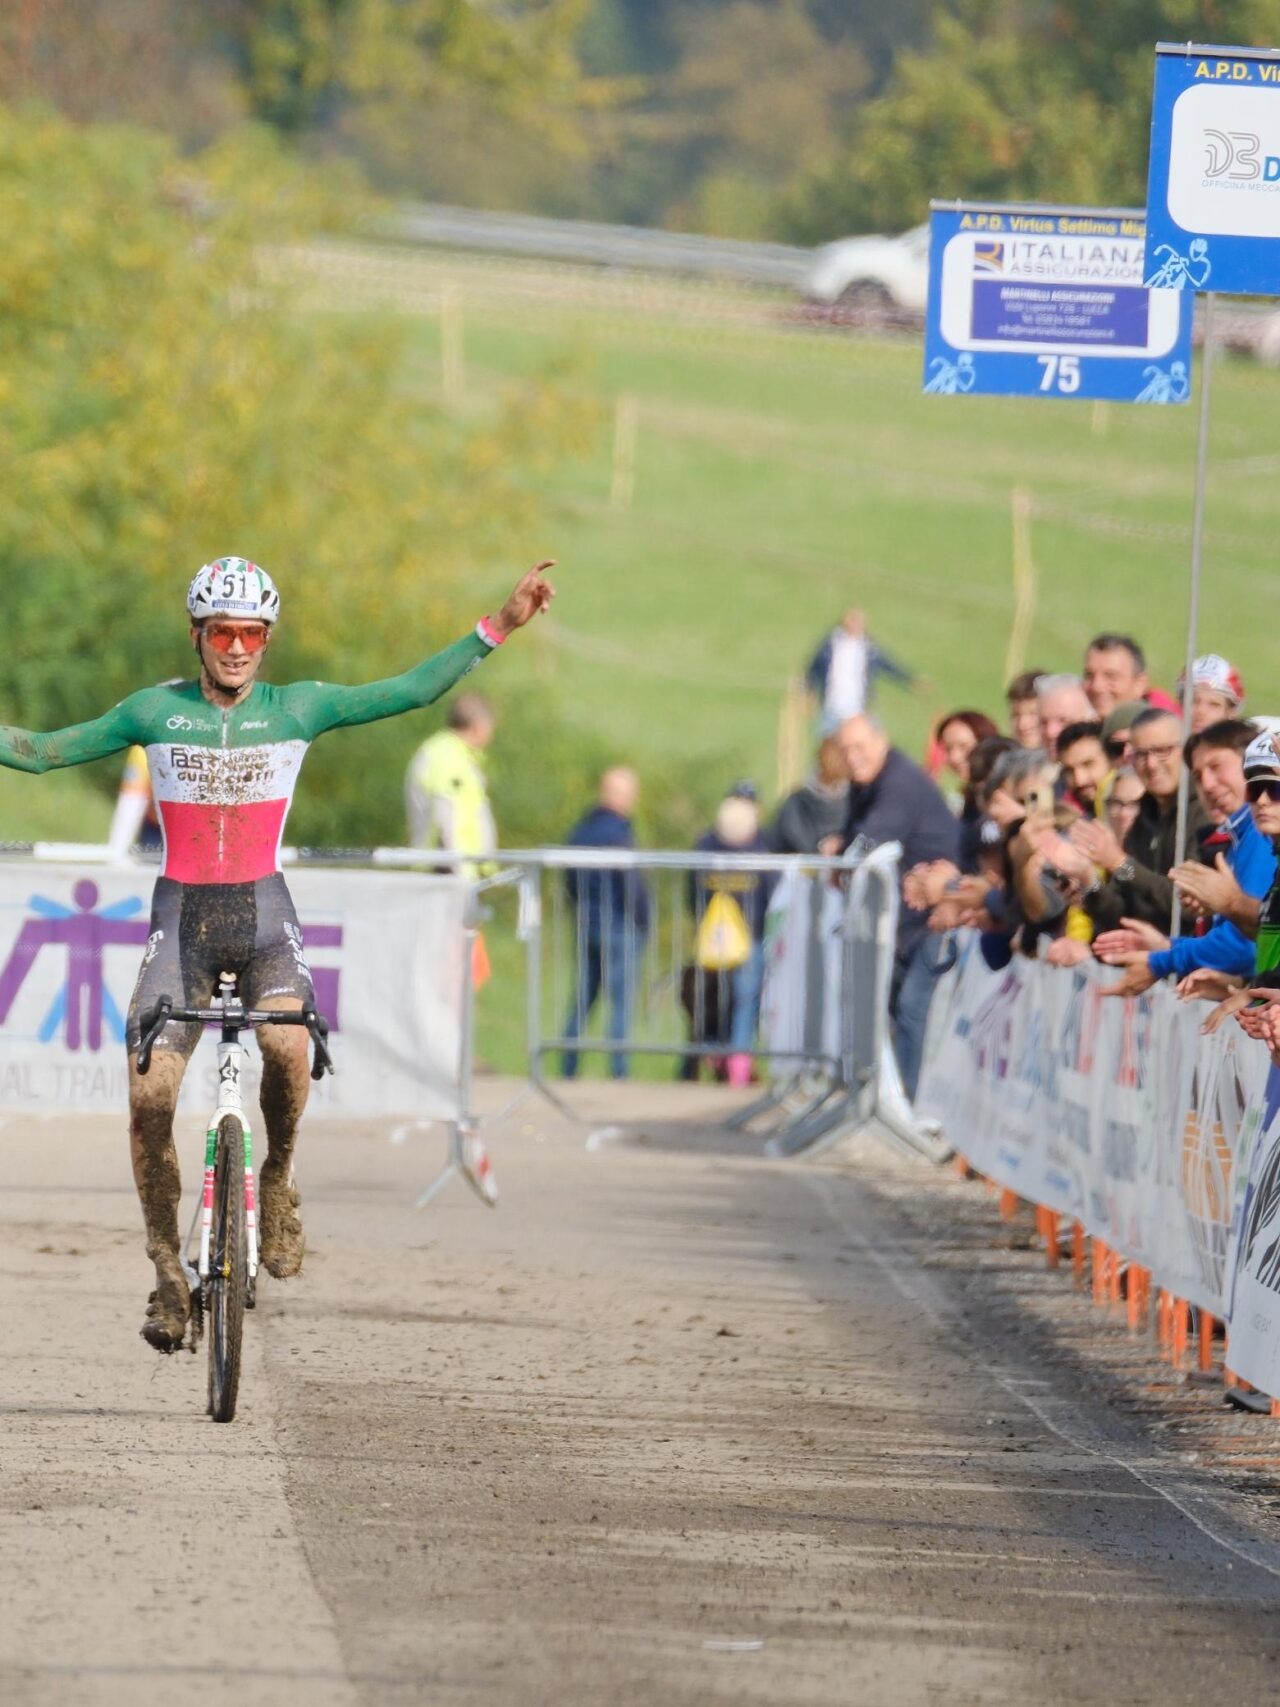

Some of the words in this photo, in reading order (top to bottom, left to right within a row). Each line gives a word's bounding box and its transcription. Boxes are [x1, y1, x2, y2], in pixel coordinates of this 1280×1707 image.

[1195, 61, 1253, 81] A.P.D.
[1259, 63, 1280, 82] Vi
[1201, 179, 1246, 190] OFFICINA
[960, 213, 1005, 232] A.P.D.
[1010, 216, 1054, 234] Virtus
[1058, 218, 1117, 236] Settimo
[1037, 355, 1081, 393] 75
[222, 573, 247, 599] 51
